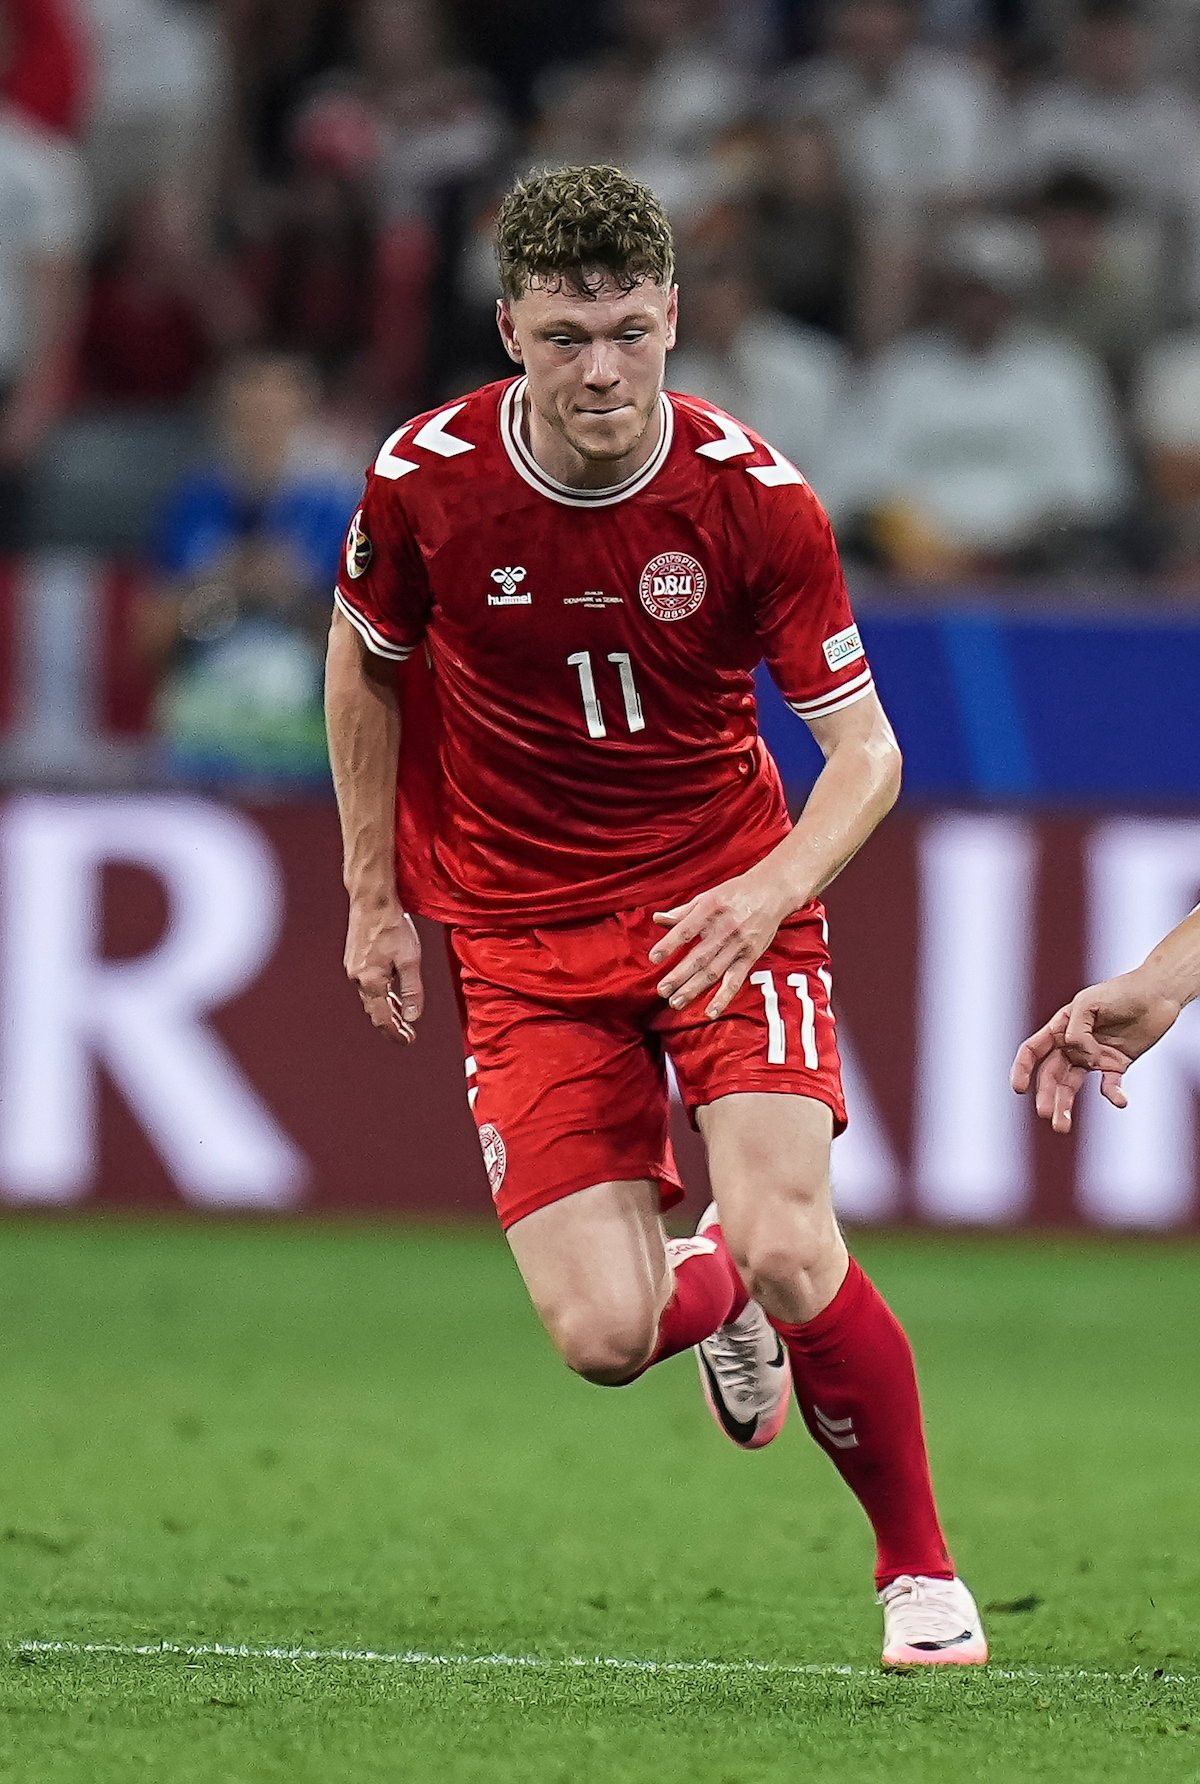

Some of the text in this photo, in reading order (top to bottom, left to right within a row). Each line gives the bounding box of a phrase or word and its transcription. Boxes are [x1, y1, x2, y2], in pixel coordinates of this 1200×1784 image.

[487, 592, 532, 606] hummel
[653, 575, 692, 596] DBU
[567, 651, 645, 738] 11
[750, 970, 818, 1070] 11
